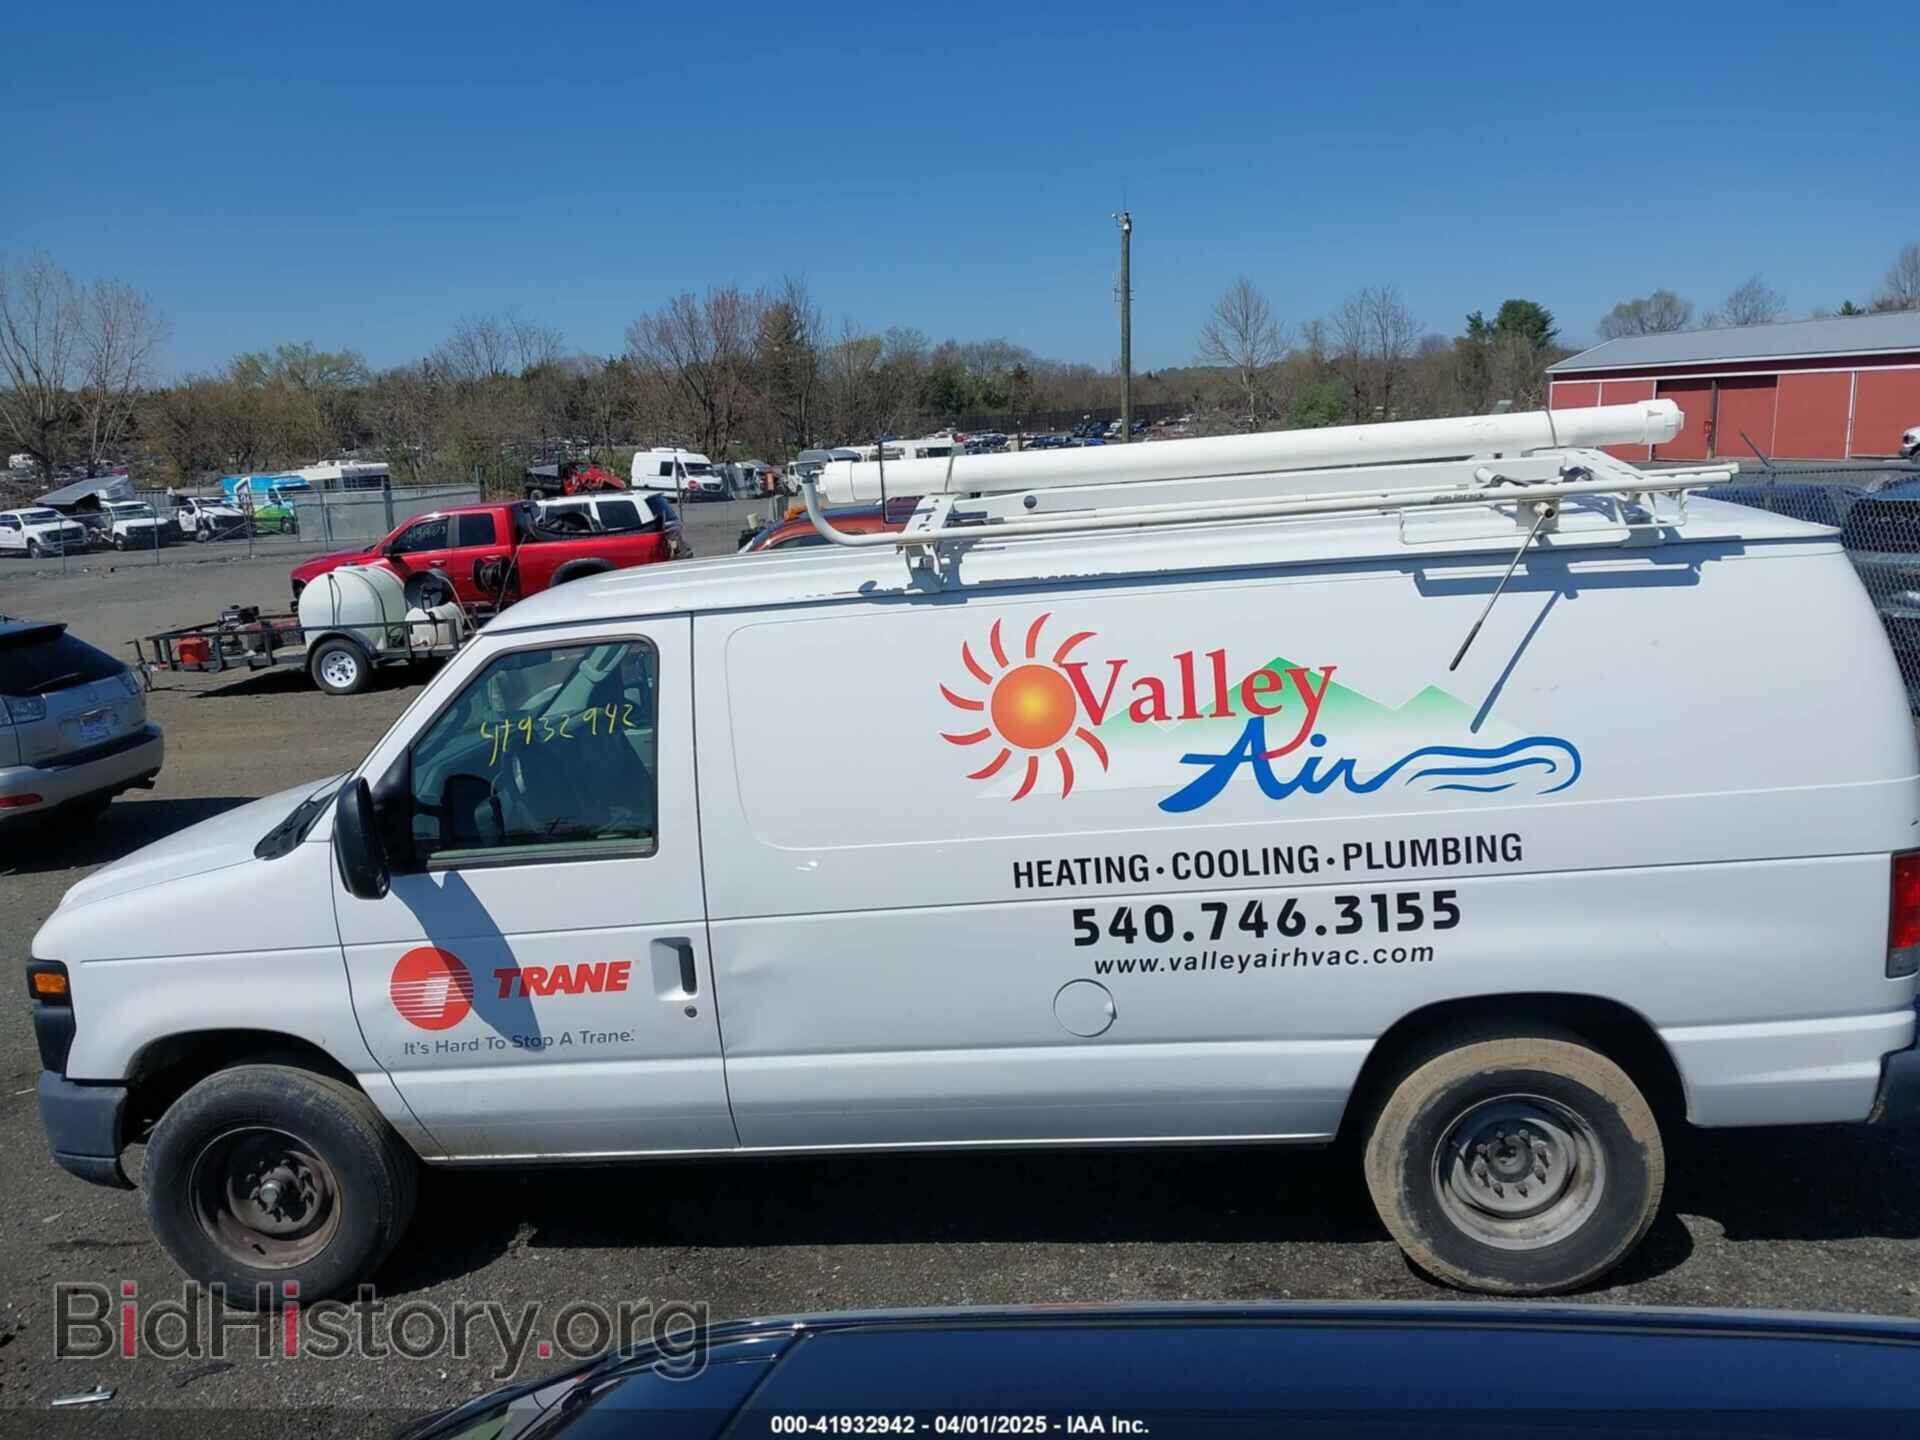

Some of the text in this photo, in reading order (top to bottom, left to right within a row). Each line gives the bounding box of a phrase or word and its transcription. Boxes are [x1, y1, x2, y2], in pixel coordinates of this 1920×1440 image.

[1058, 647, 1337, 760] Valley
[1157, 716, 1395, 813] Air
[1072, 889, 1461, 947] 540.746.3155
[493, 961, 632, 999] TRANE
[1094, 945, 1434, 975] www.valleyairhvac.com
[434, 1036, 480, 1054] Hard
[486, 1036, 507, 1051] To
[512, 1033, 554, 1050] Stop
[559, 1031, 573, 1046] A
